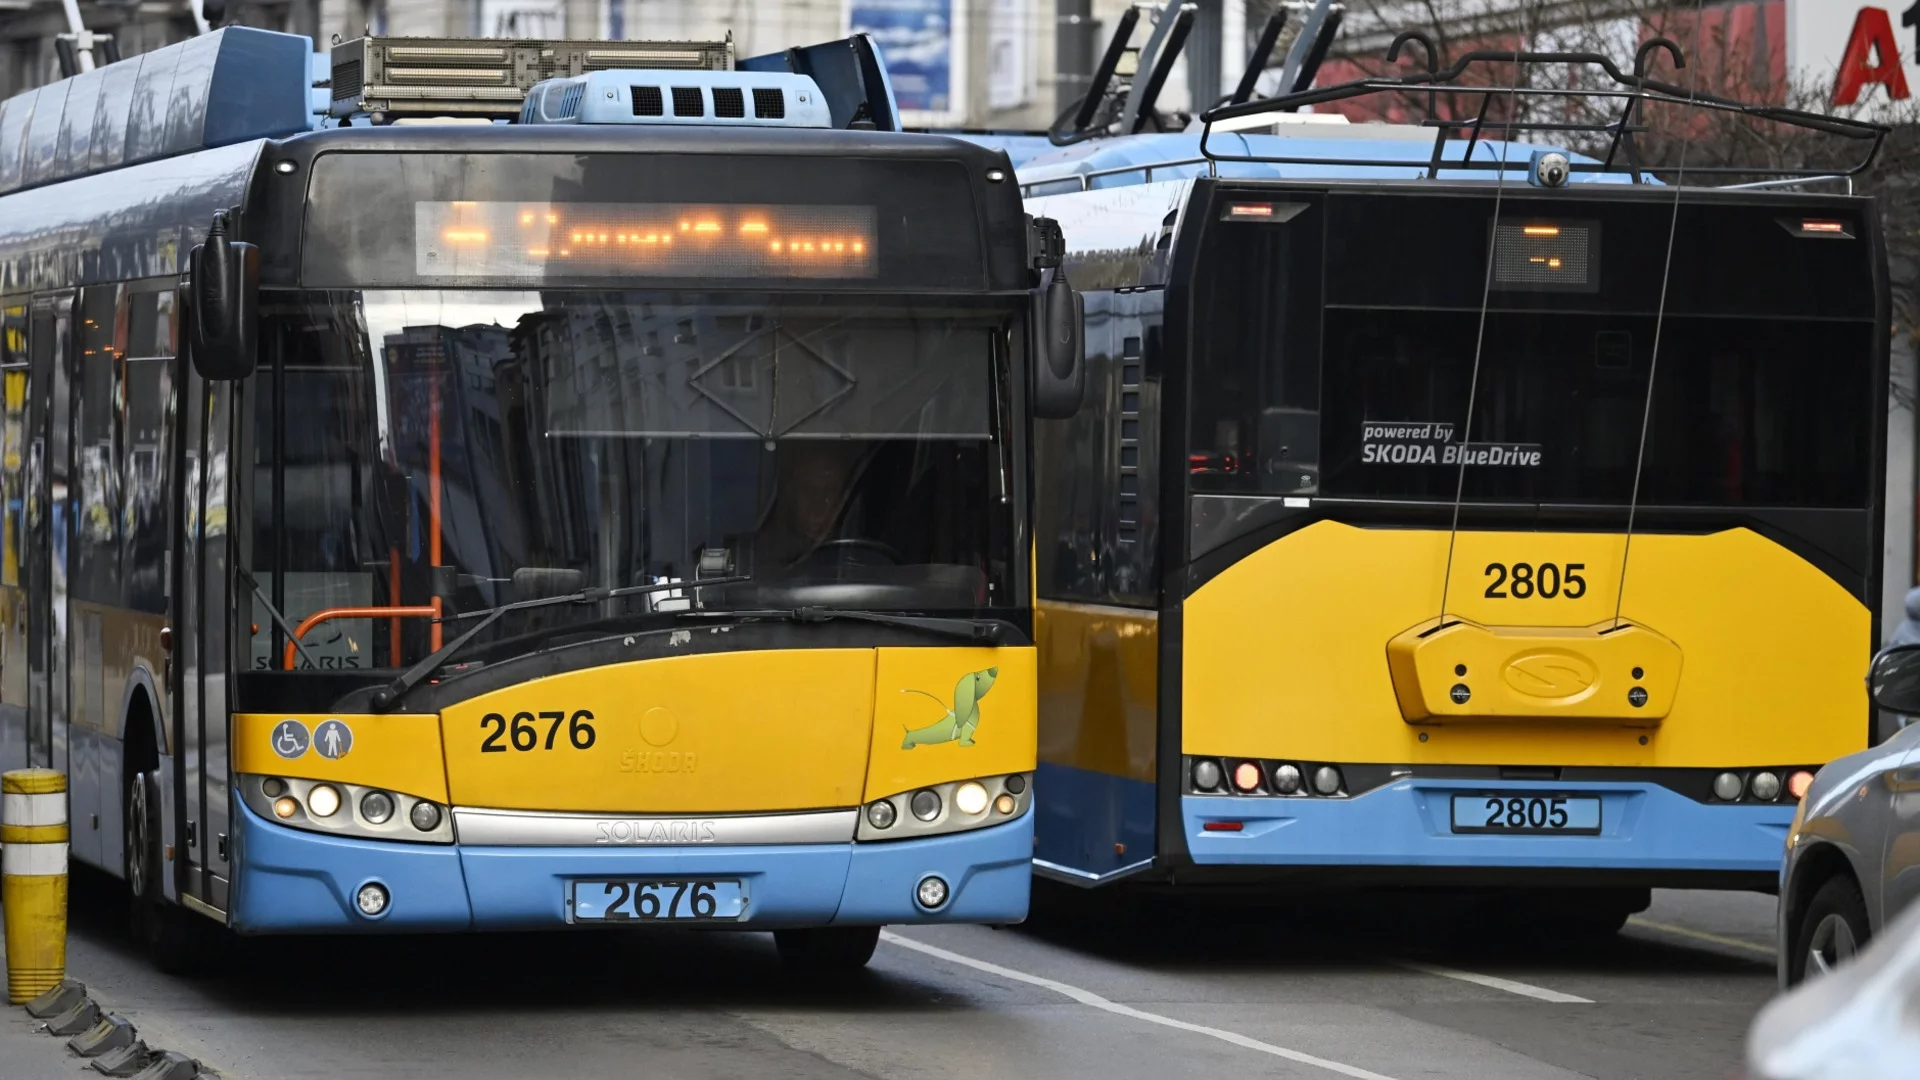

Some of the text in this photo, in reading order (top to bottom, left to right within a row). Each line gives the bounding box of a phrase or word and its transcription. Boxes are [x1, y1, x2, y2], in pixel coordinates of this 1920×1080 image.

[1363, 425, 1453, 443] powered by
[1362, 444, 1541, 466] SKODA BlueDrive
[1484, 562, 1586, 599] 2805
[480, 709, 596, 753] 2676
[620, 748, 698, 773] ŠKODA
[1485, 798, 1568, 828] 2805
[595, 821, 716, 843] SOLARIS
[603, 881, 717, 919] 2676
